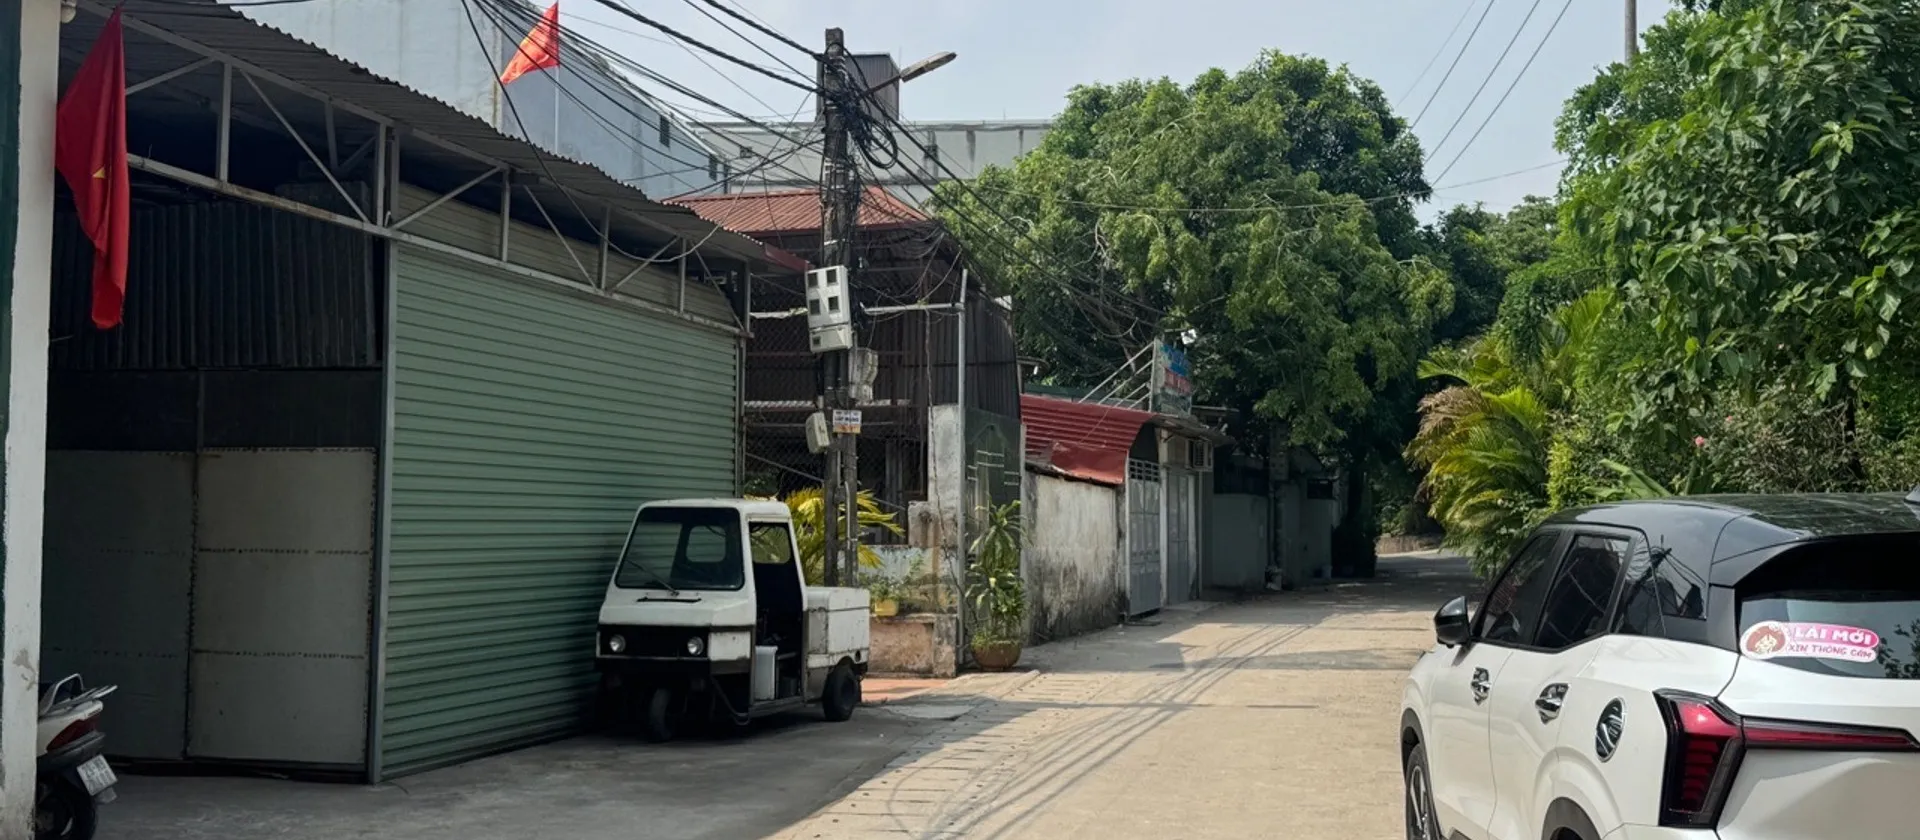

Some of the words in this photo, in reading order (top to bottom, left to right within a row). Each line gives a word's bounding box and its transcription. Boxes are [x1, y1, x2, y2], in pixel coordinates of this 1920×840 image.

[1795, 625, 1828, 639] LÁI
[1832, 628, 1872, 645] MỚI
[1788, 643, 1808, 653] XIN
